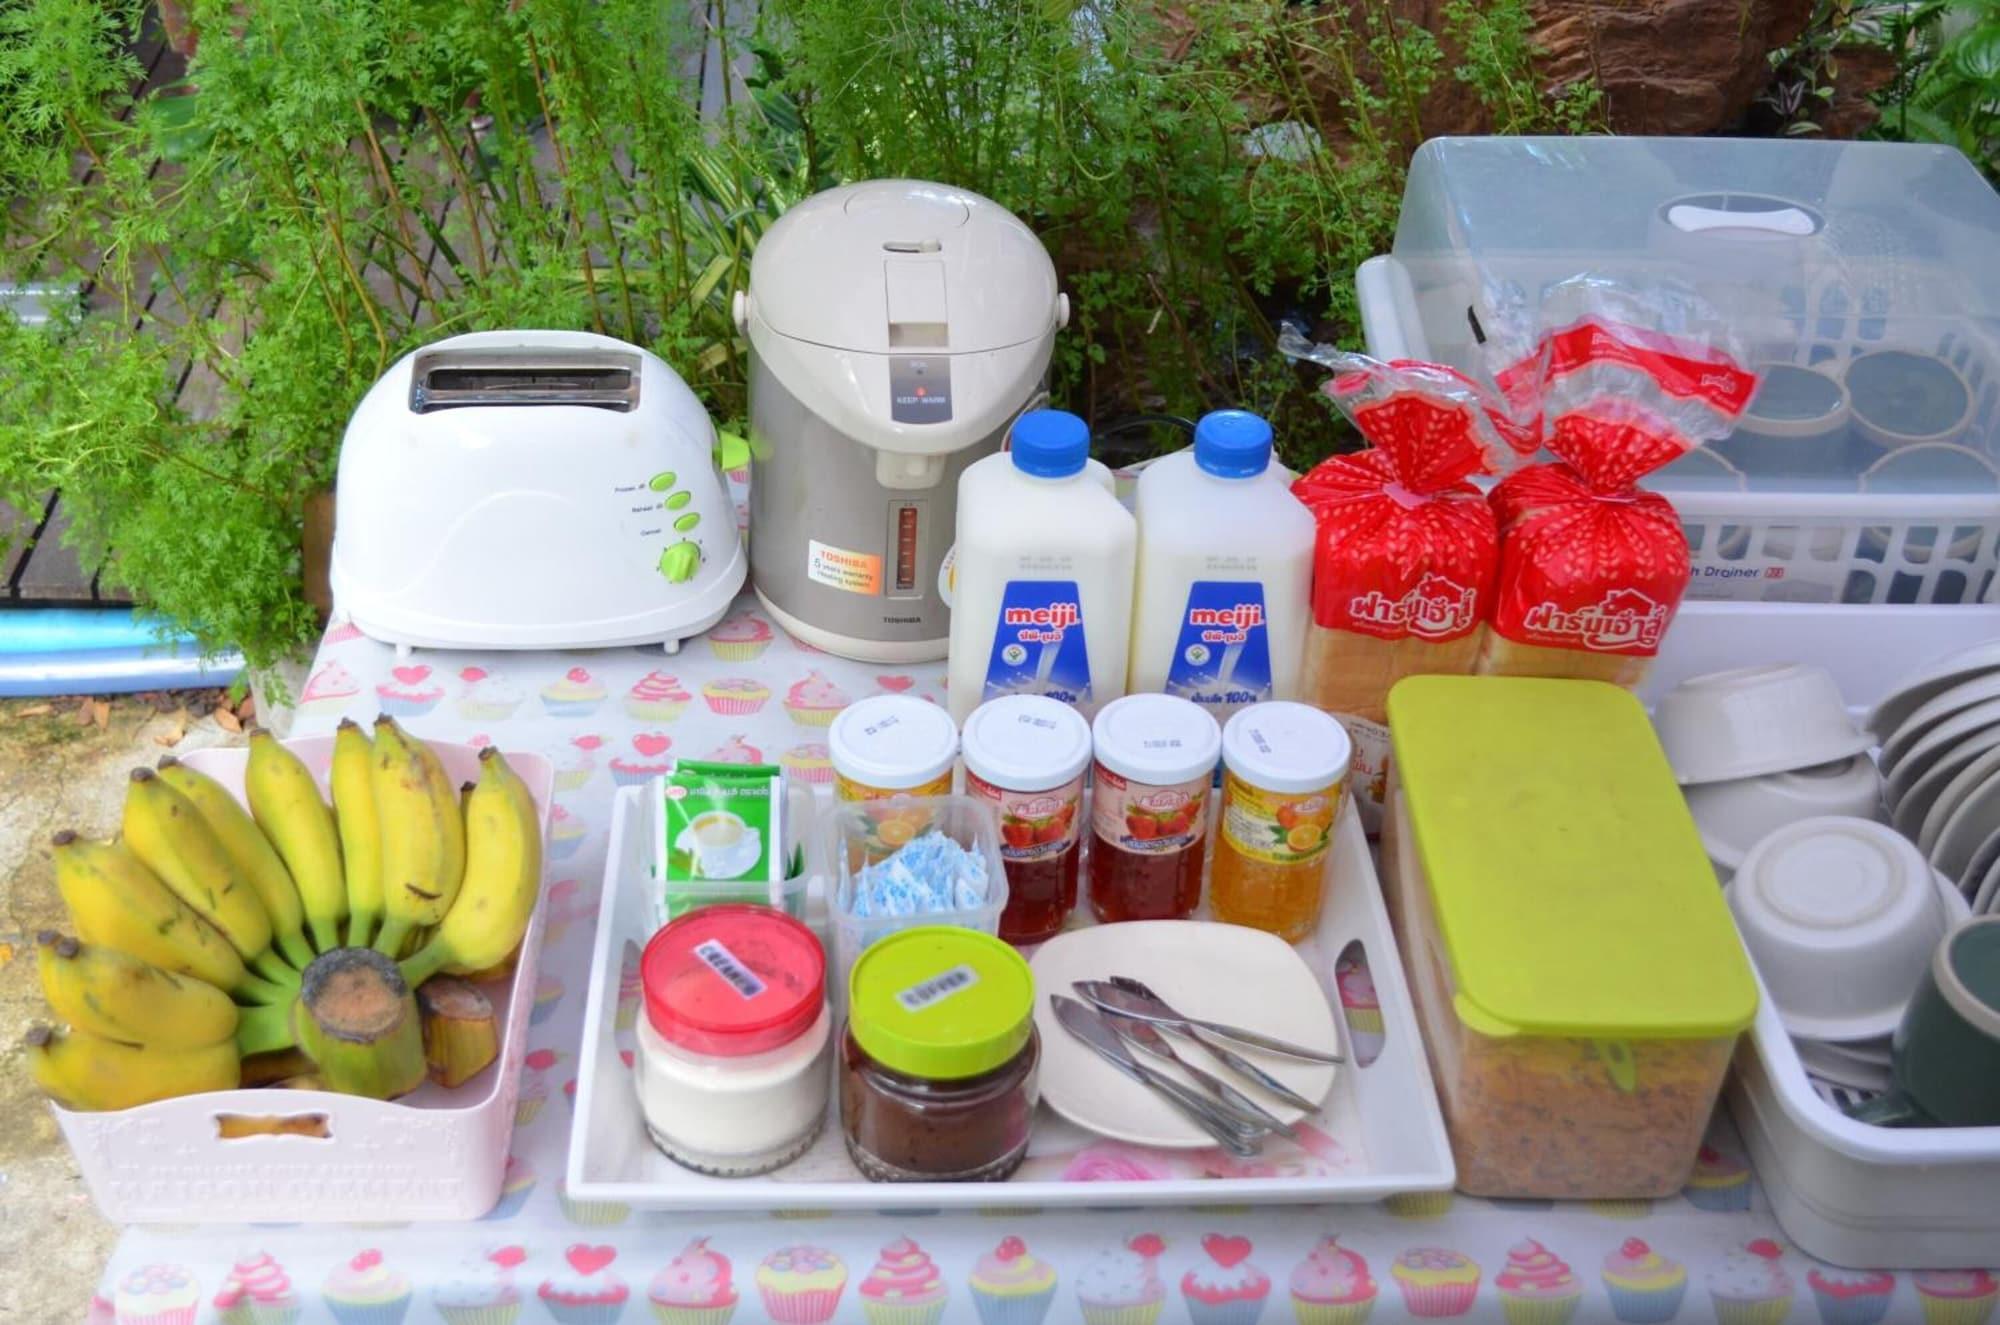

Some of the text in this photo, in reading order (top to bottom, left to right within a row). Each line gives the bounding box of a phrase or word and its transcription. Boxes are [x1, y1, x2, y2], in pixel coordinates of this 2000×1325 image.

[896, 396, 946, 404] KEEP WARM
[820, 550, 867, 568] TOSHIBA
[1704, 566, 1760, 578] Drainer
[1006, 604, 1076, 629] meiji
[1191, 605, 1261, 630] meiji
